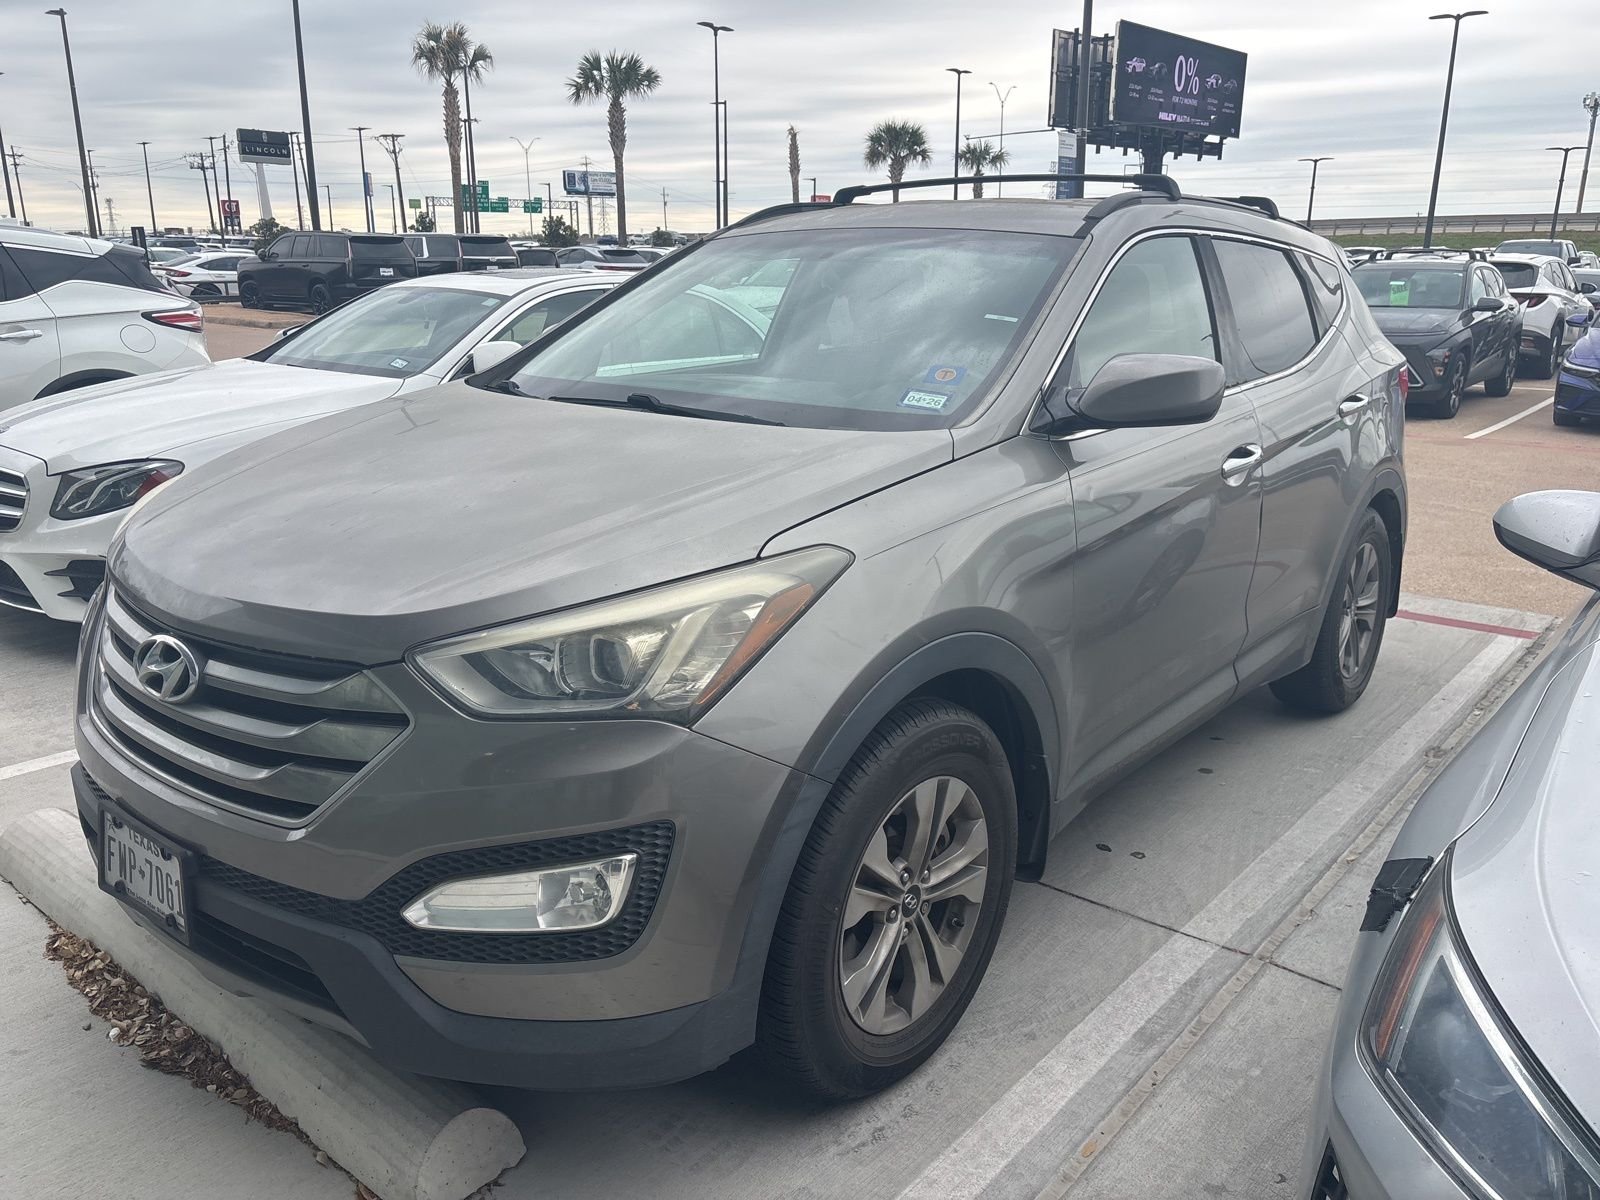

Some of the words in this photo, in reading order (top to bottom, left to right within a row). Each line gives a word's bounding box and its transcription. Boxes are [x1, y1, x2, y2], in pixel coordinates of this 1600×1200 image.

[1174, 54, 1200, 95] 0%
[245, 146, 288, 155] LINCOLN
[1391, 284, 1408, 295] SALE
[127, 828, 160, 858] TEXAS
